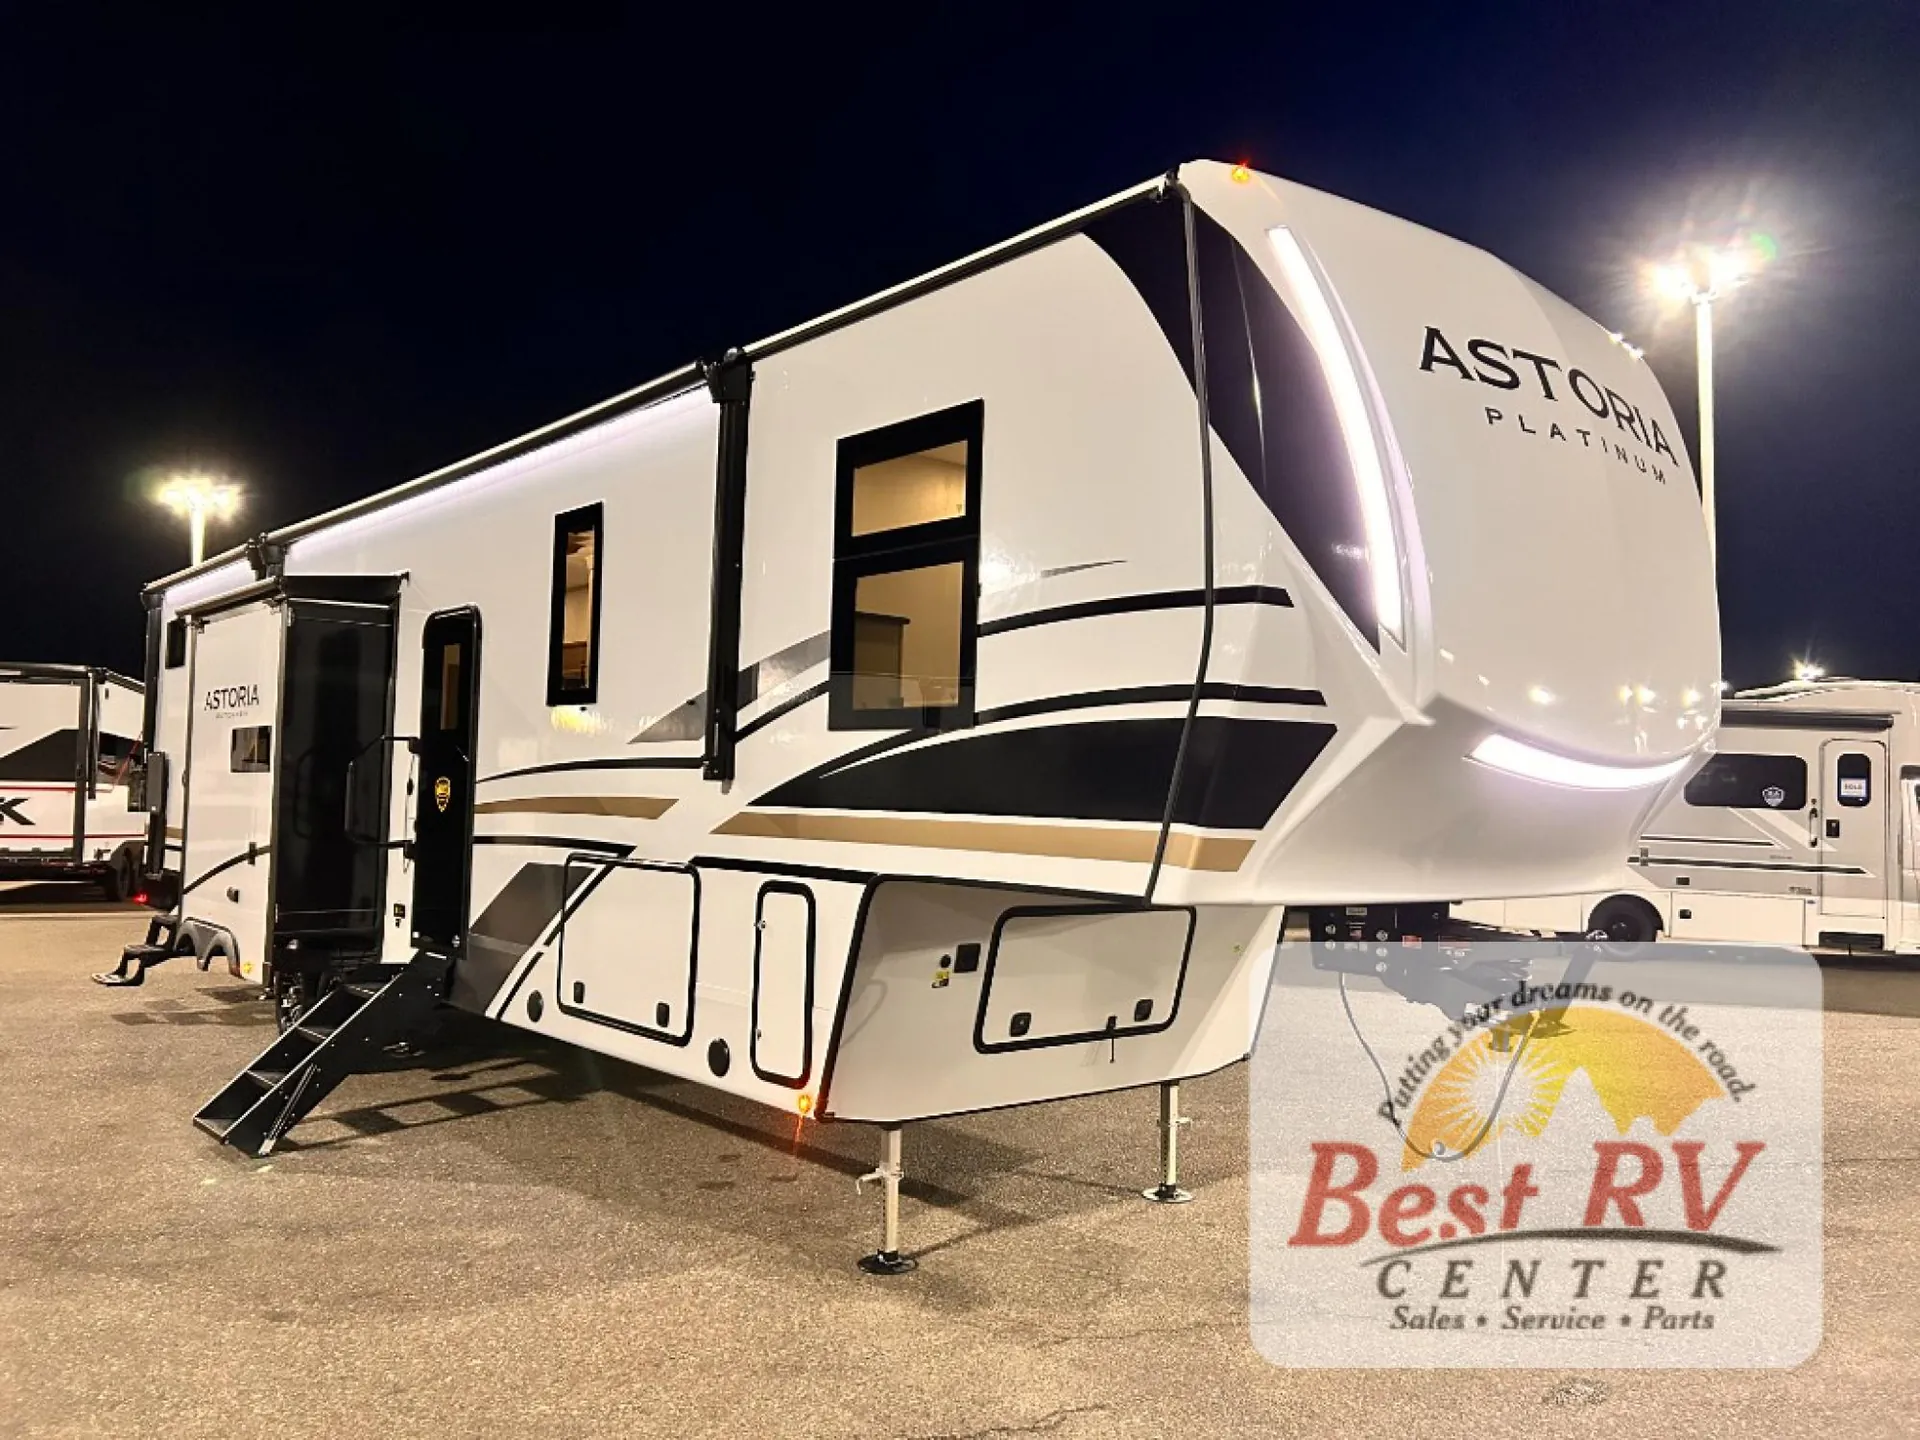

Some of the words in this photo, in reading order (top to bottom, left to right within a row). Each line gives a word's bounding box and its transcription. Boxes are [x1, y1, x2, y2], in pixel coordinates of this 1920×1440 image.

[1419, 325, 1680, 468] ASTORIA
[1485, 407, 1667, 485] PLATINUM
[204, 684, 259, 711] ASTORIA
